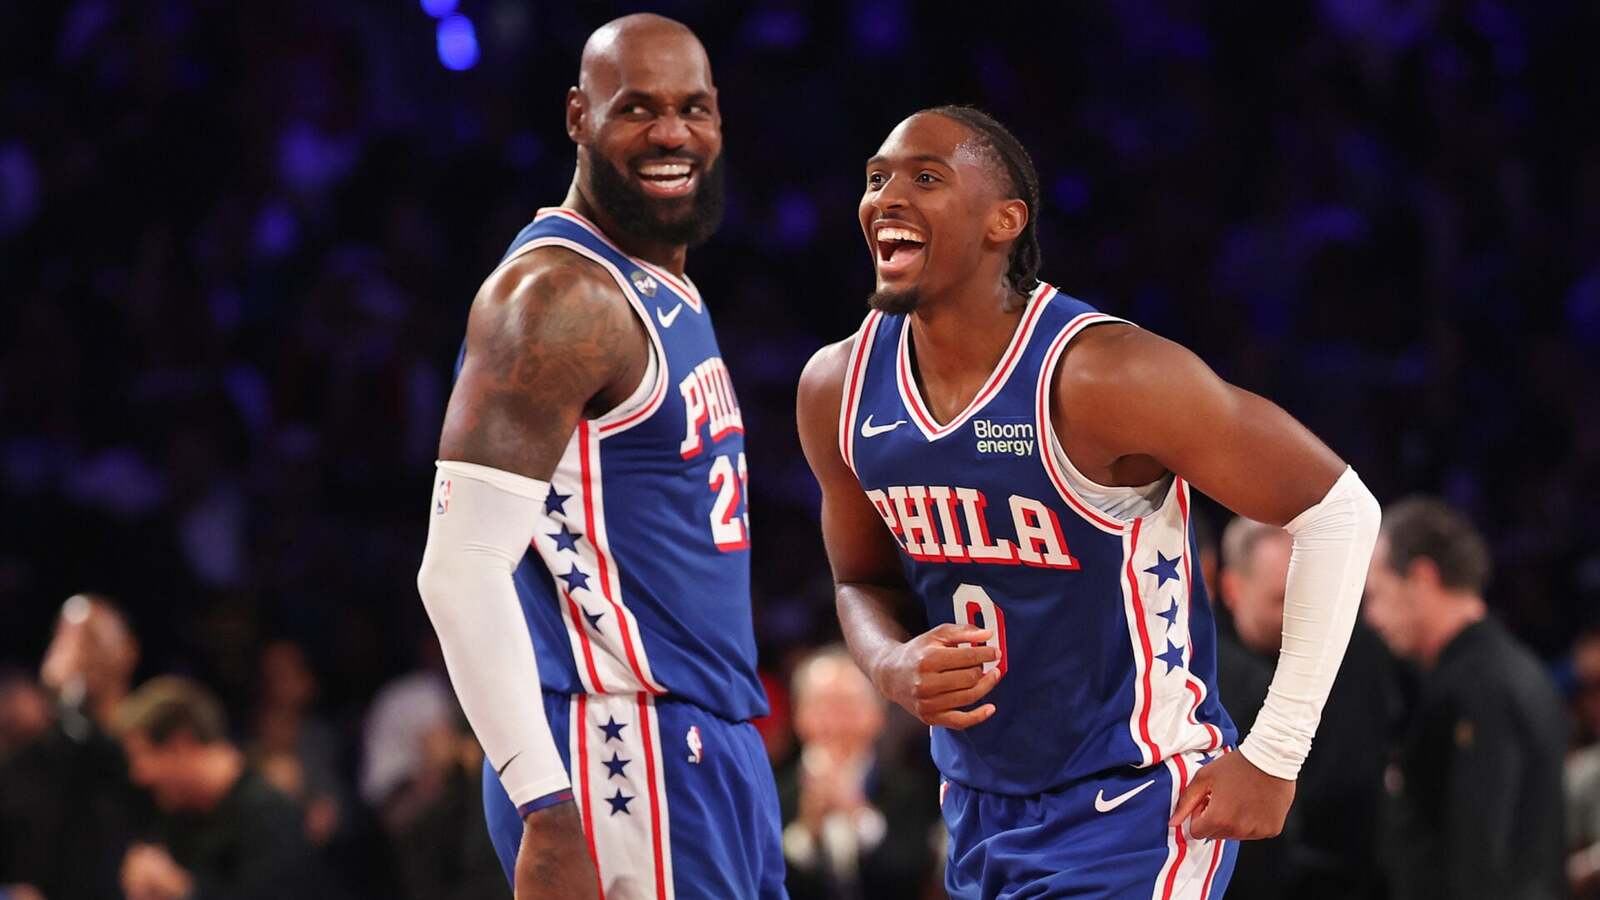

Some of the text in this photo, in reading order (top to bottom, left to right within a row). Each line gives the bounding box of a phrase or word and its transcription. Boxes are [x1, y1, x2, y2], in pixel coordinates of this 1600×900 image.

[973, 419, 1034, 438] Bloom
[976, 440, 1034, 456] energy
[865, 486, 1081, 570] PHILA
